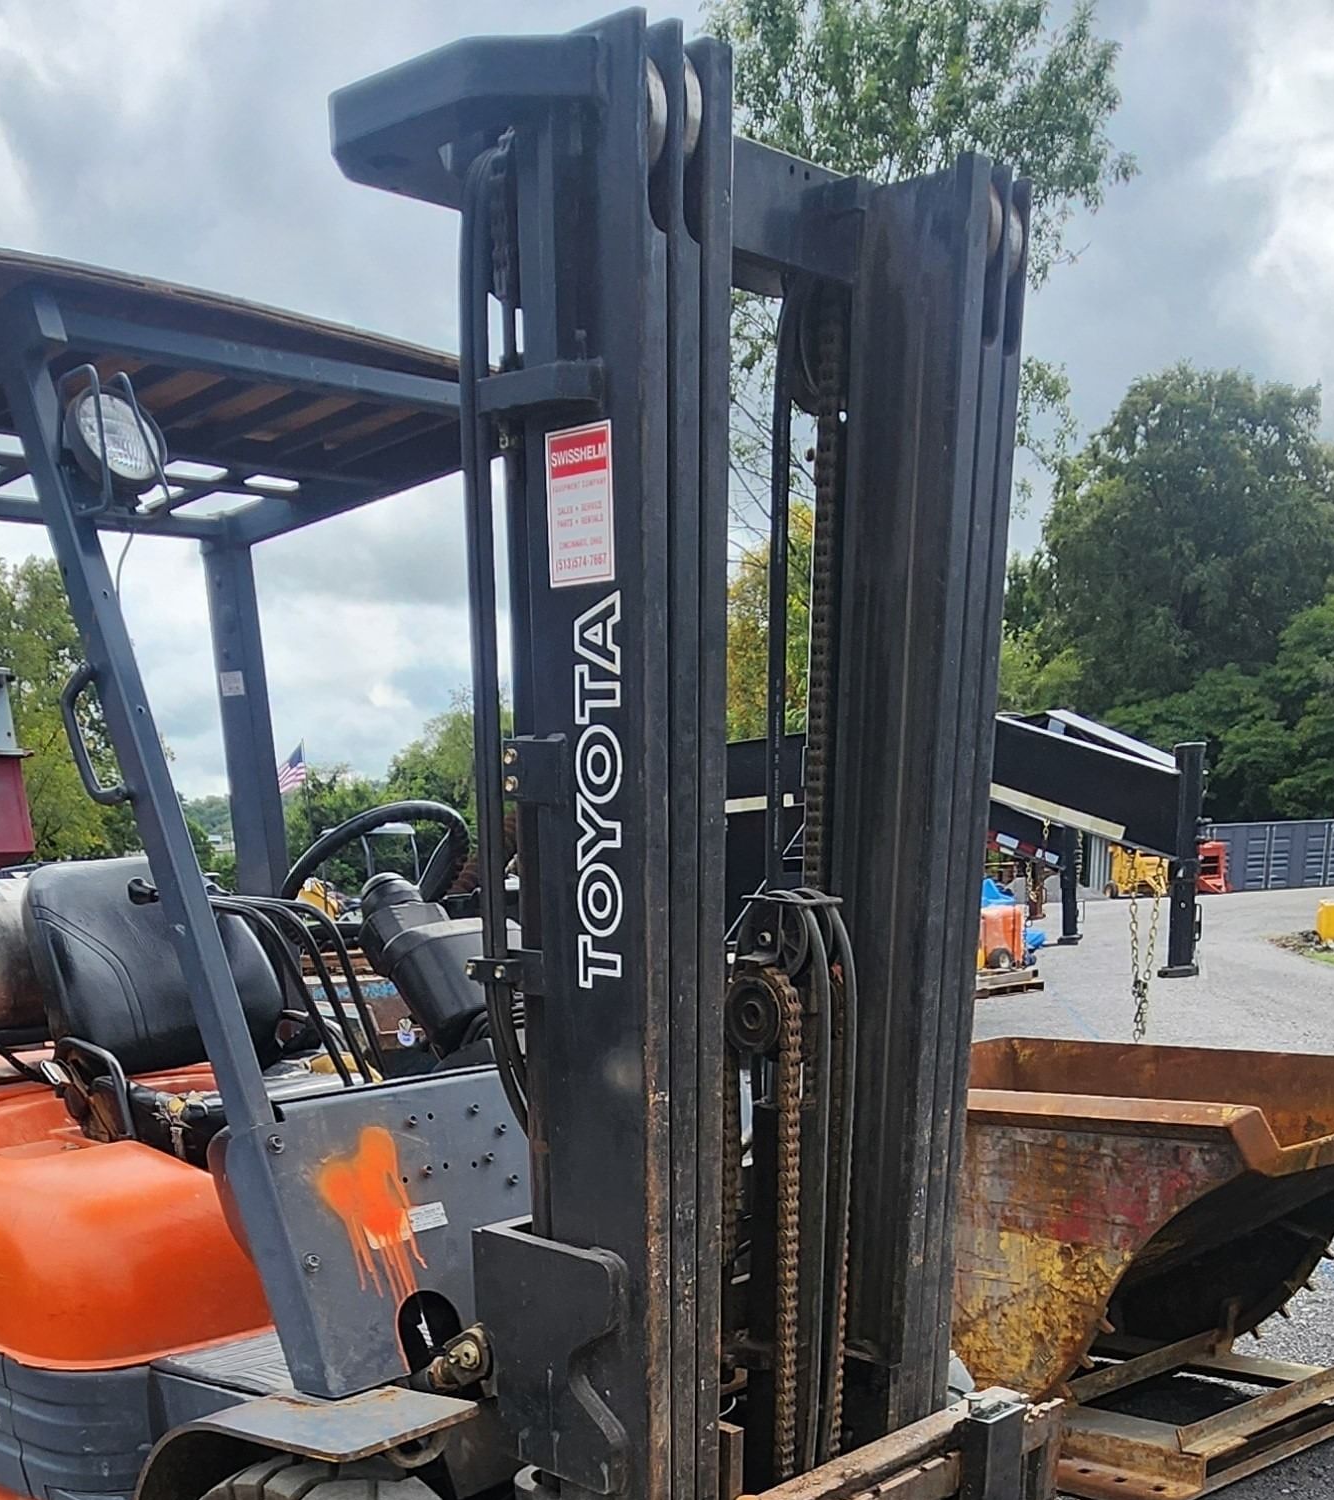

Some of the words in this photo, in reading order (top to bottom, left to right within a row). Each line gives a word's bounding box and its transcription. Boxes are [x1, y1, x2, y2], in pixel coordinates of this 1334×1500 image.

[551, 442, 607, 469] SWISSHELM
[552, 481, 580, 494] EQUIPMENT
[581, 477, 607, 489] COMPANY
[556, 505, 573, 515] SALES
[556, 519, 573, 528] PARTS
[574, 589, 622, 989] TOYOTA
